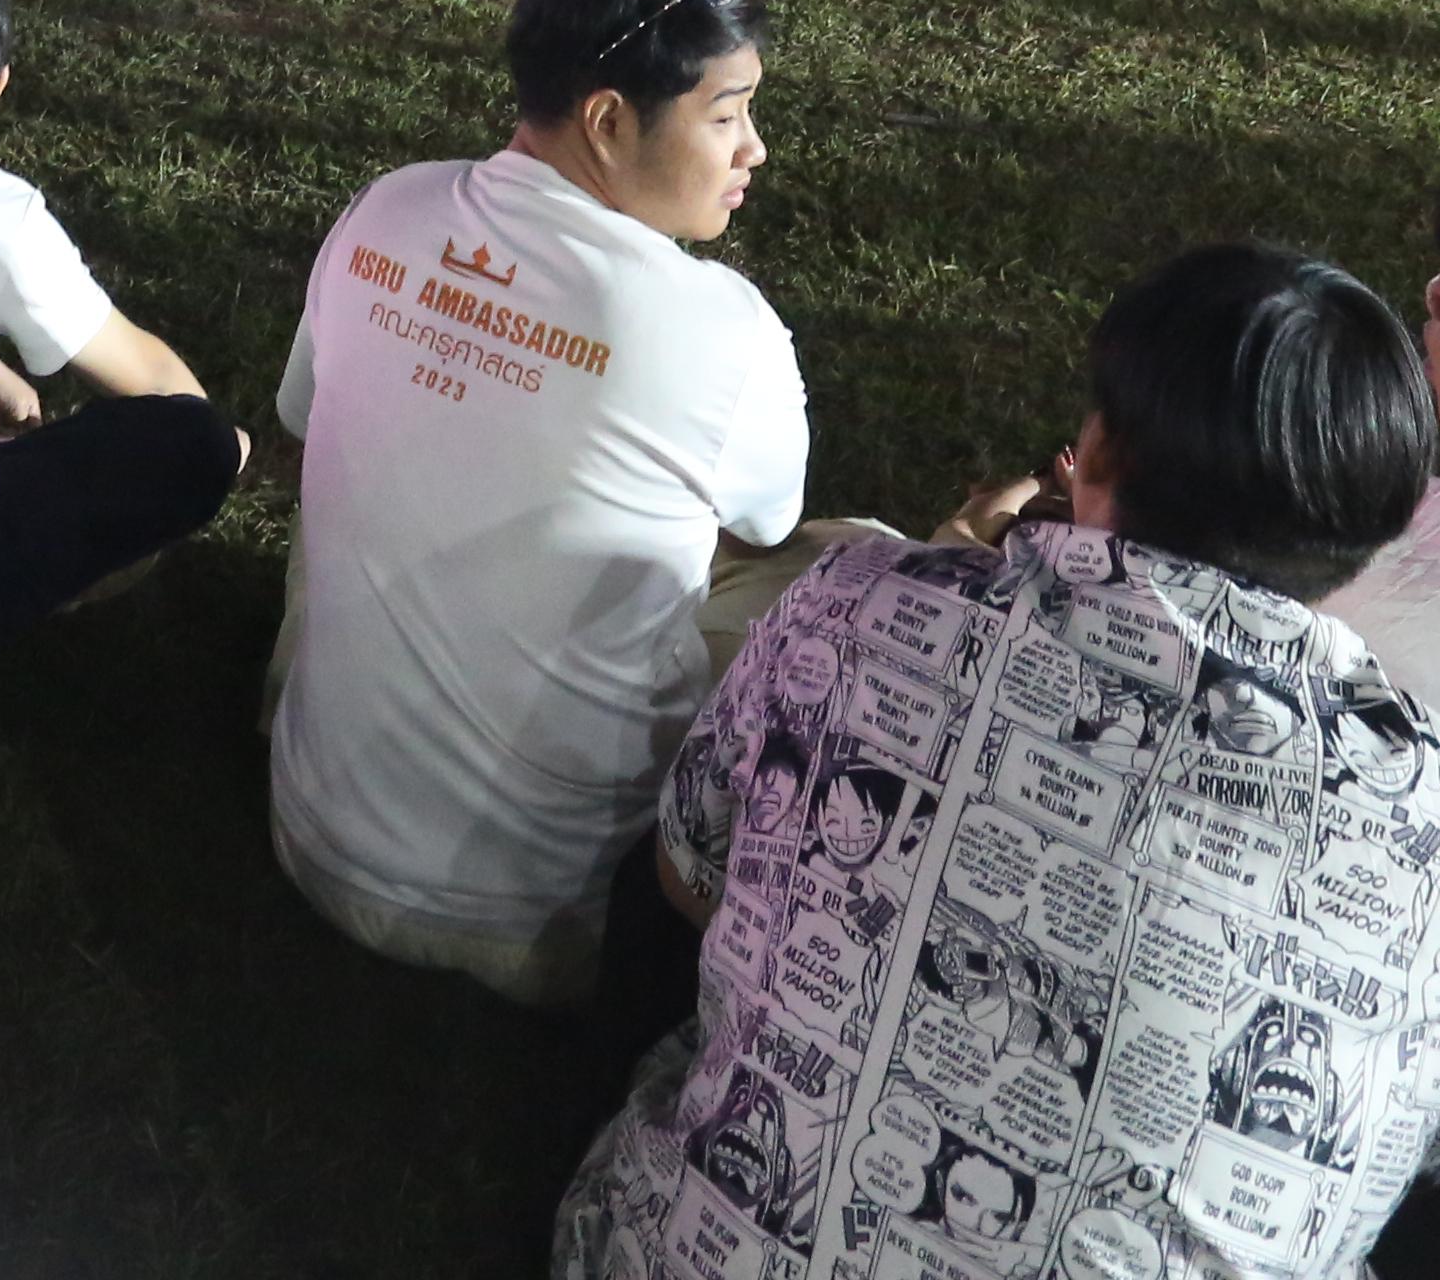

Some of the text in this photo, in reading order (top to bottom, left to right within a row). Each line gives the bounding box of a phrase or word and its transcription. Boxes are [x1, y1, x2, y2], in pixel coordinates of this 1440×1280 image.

[348, 245, 611, 377] NSRU AMBASSADOR
[369, 302, 546, 393] คณะครุศาสตร์
[411, 364, 467, 402] 2023
[1108, 622, 1145, 641] BOUNTY
[1105, 639, 1147, 659] MILLION
[1025, 750, 1104, 793] CYBORG FRANKY
[1199, 752, 1238, 773] DEAD
[1244, 757, 1263, 779] OR
[1039, 776, 1078, 799] BOUNTY
[1198, 773, 1271, 816] RORONOA
[1036, 793, 1078, 819] MILLION
[1166, 803, 1282, 855] PIRATE HUNTER ZORO
[1361, 819, 1386, 838] OR
[1199, 836, 1243, 859] BOUNTY
[1195, 854, 1242, 878] MILLION
[1346, 863, 1389, 889] 500
[1313, 871, 1405, 920] MILLION!
[1315, 896, 1389, 937] YAHOO!
[807, 936, 841, 960] 500
[781, 946, 857, 993] MILLION!
[1129, 970, 1166, 988] COME
[1199, 972, 1224, 987] DID
[780, 970, 843, 1011] YAHOO!
[1167, 973, 1221, 998] AMOUNT
[1230, 1163, 1252, 1180] GOD
[1229, 1187, 1271, 1212] BOUNTY
[1224, 1209, 1265, 1232] MILLION
